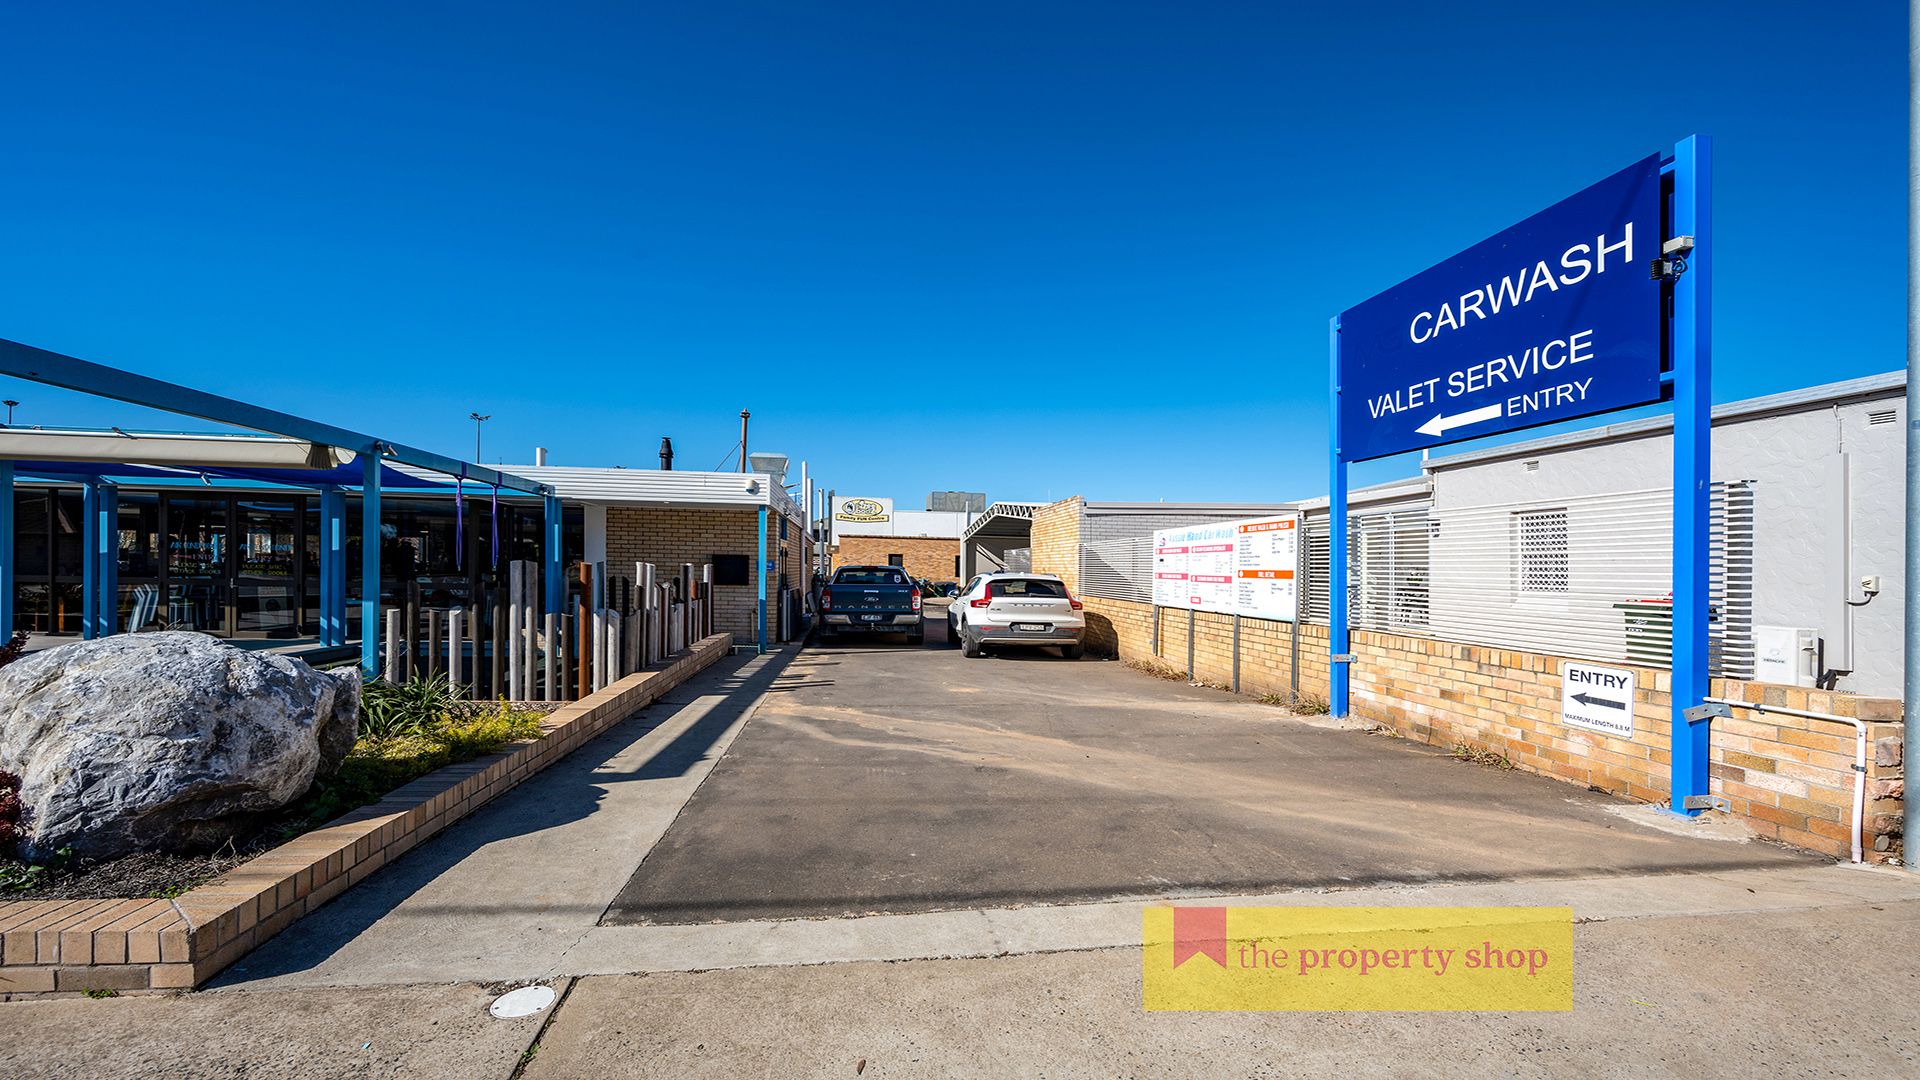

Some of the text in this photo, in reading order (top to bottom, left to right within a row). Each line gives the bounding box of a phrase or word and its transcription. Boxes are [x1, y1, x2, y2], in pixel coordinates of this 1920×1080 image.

[1409, 221, 1633, 344] CARWASH
[1367, 329, 1595, 419] VALET SERVICE
[1506, 377, 1594, 418] ENTRY
[1569, 668, 1628, 689] ENTRY
[1564, 713, 1591, 723] MAXIMUM
[1592, 719, 1614, 728] LENGTH
